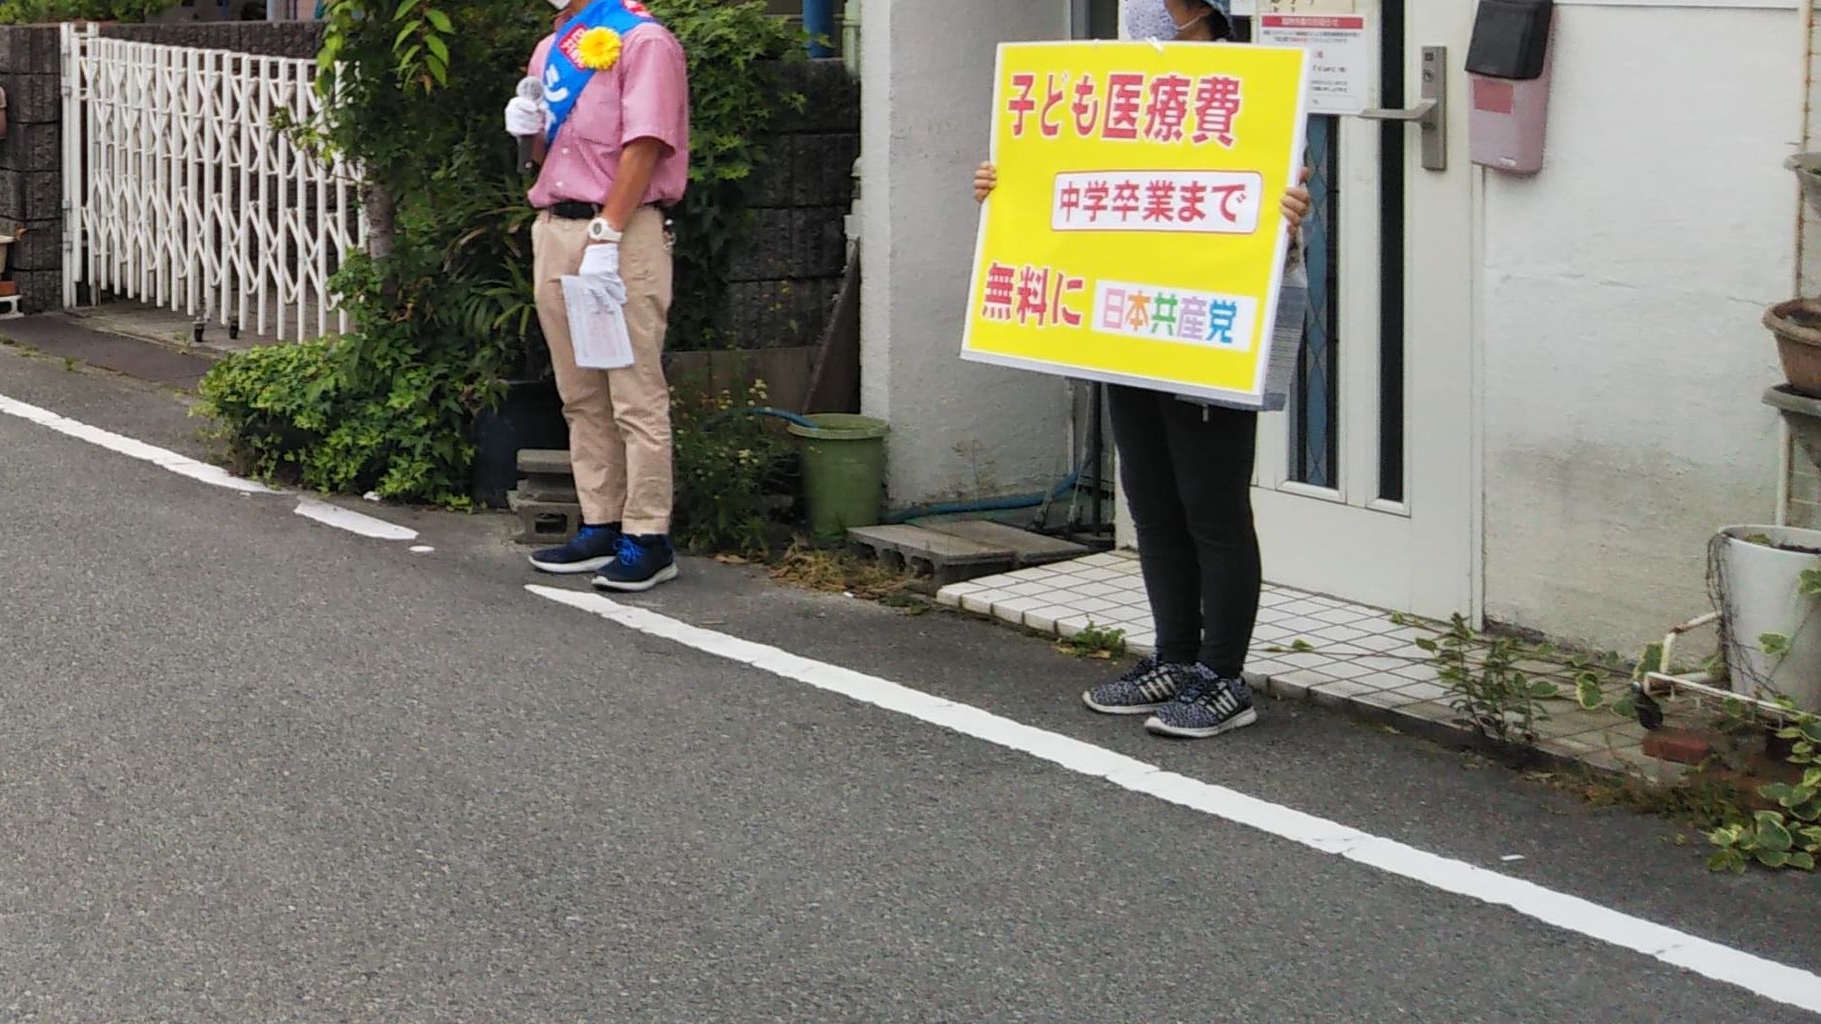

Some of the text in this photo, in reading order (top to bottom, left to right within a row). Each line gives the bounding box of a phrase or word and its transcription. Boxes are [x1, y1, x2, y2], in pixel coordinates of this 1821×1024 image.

[1007, 73, 1242, 147] 子ども医療費
[1060, 179, 1247, 223] 中学卒業まで
[982, 262, 1084, 327] 無料に
[1102, 287, 1237, 344] 日本共産党
